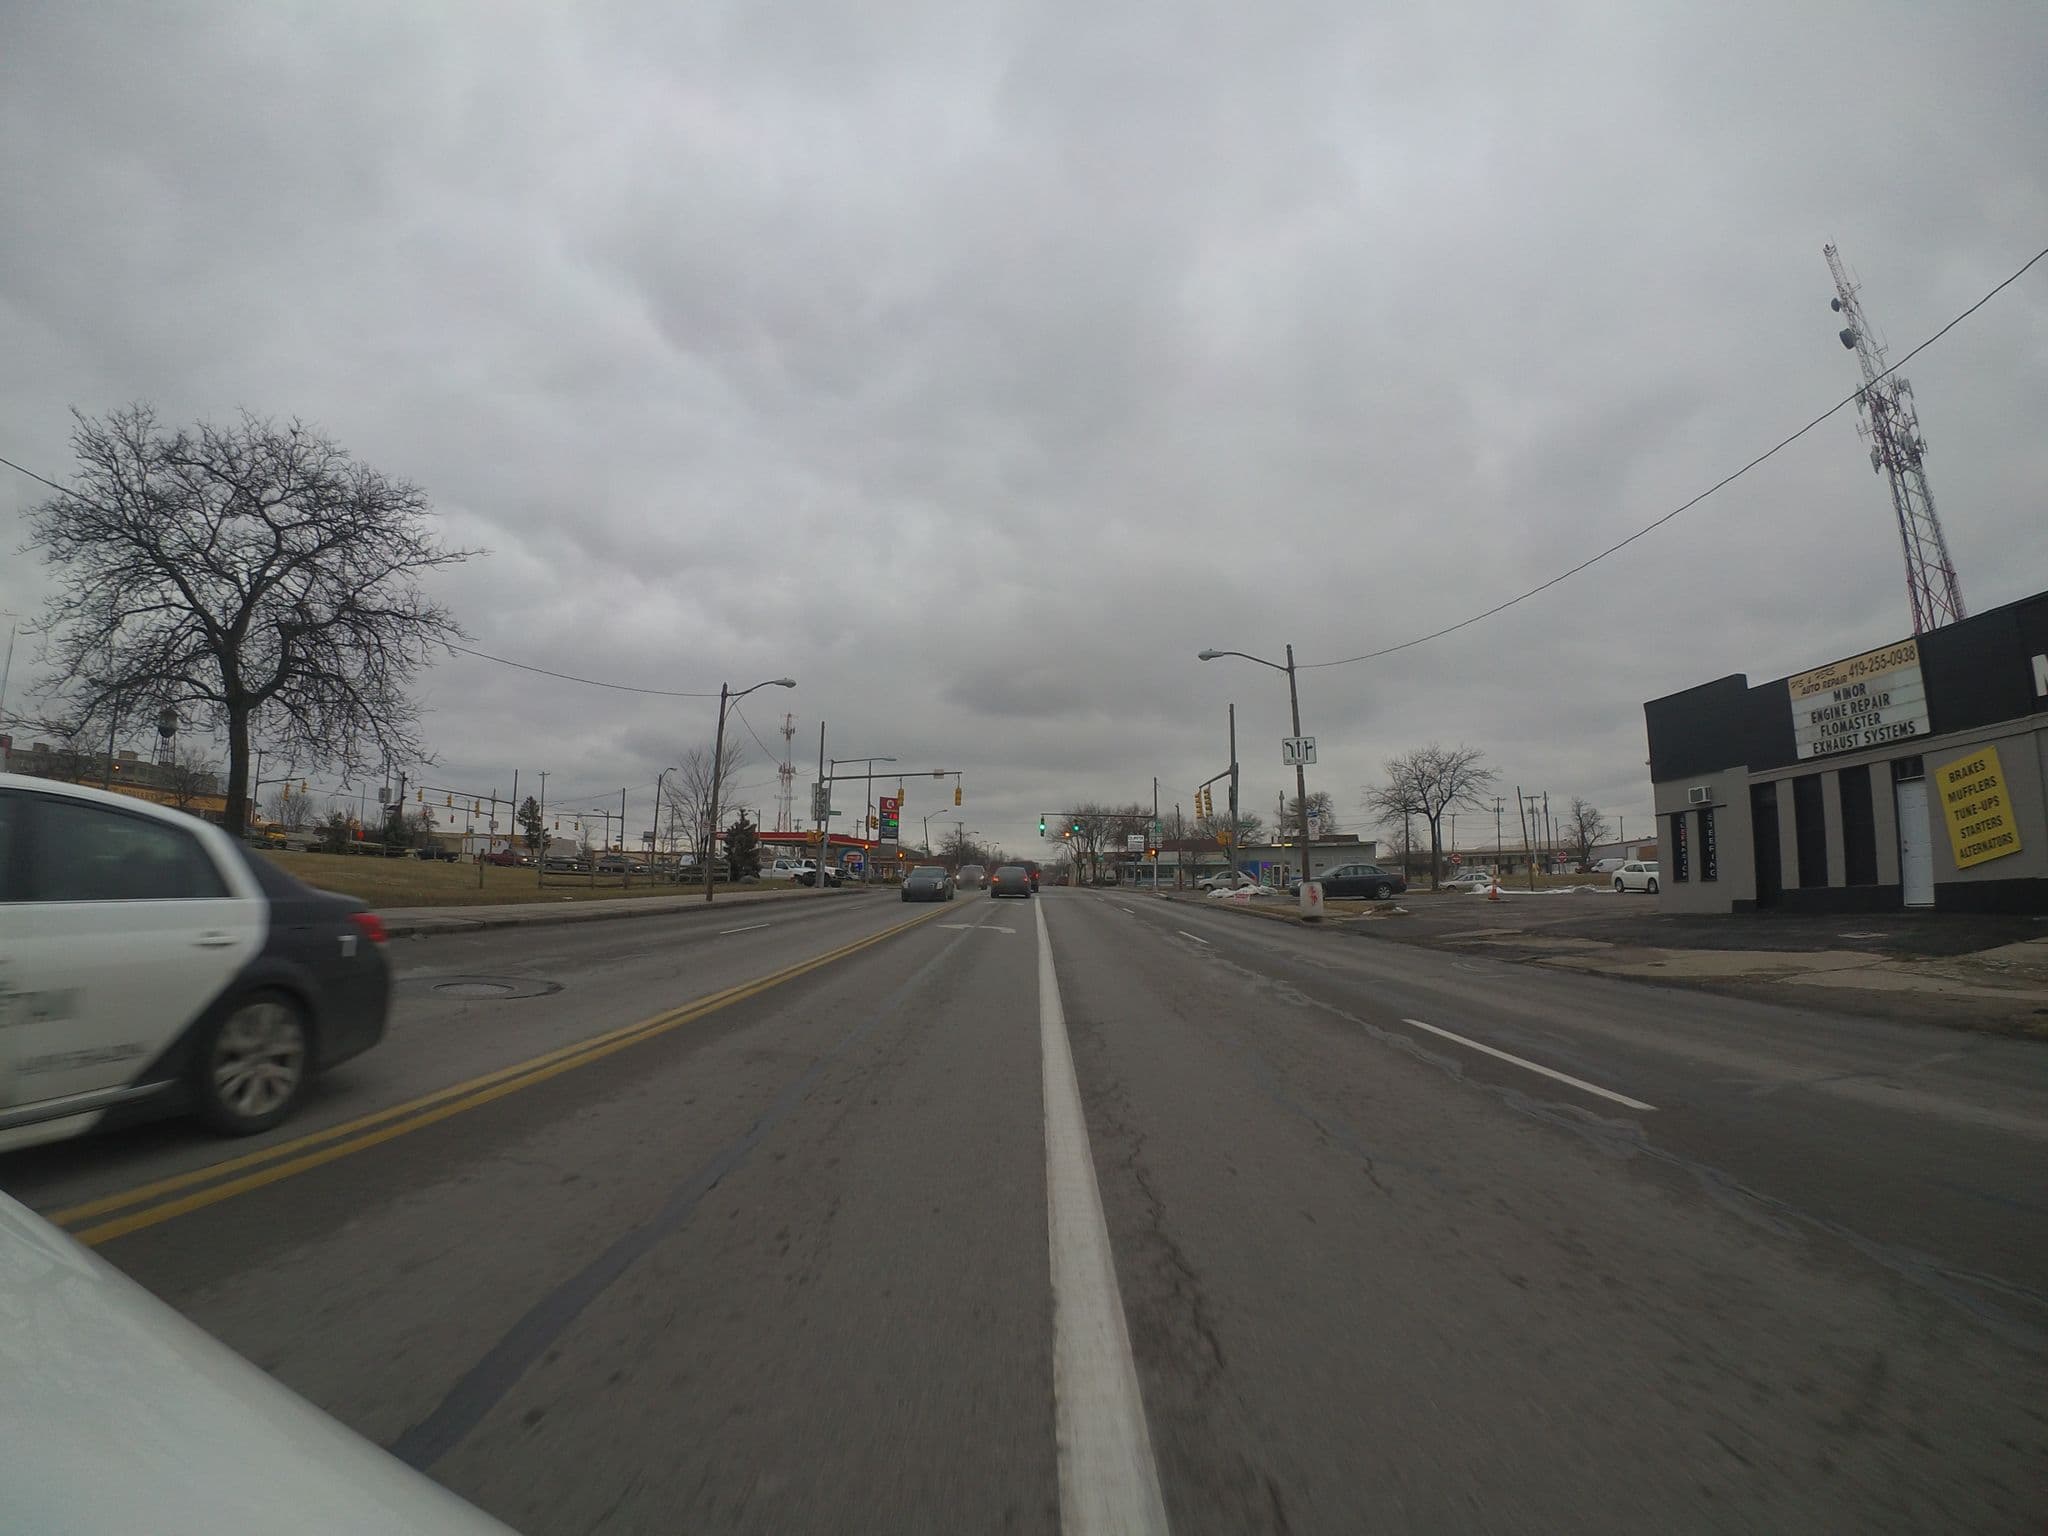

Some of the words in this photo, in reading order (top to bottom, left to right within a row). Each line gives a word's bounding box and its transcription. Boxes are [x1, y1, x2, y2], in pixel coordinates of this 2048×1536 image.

[1848, 645, 1916, 678] 419-255-0938
[1801, 681, 1820, 696] AUTO
[1822, 675, 1848, 690] REPAIR
[1833, 683, 1867, 702] MINOR
[1811, 704, 1848, 724] ENGINE
[1850, 693, 1891, 715] REPAIR
[1821, 712, 1881, 737] FLOMASTER
[1813, 733, 1859, 754] EXHAUST
[1864, 721, 1916, 744] SYSTEMS
[1948, 759, 1986, 783] BRAKES
[1947, 775, 1998, 804] MUFFLERS
[1954, 795, 2000, 821] TUNE-UPS
[1960, 815, 2003, 839] STARTERS
